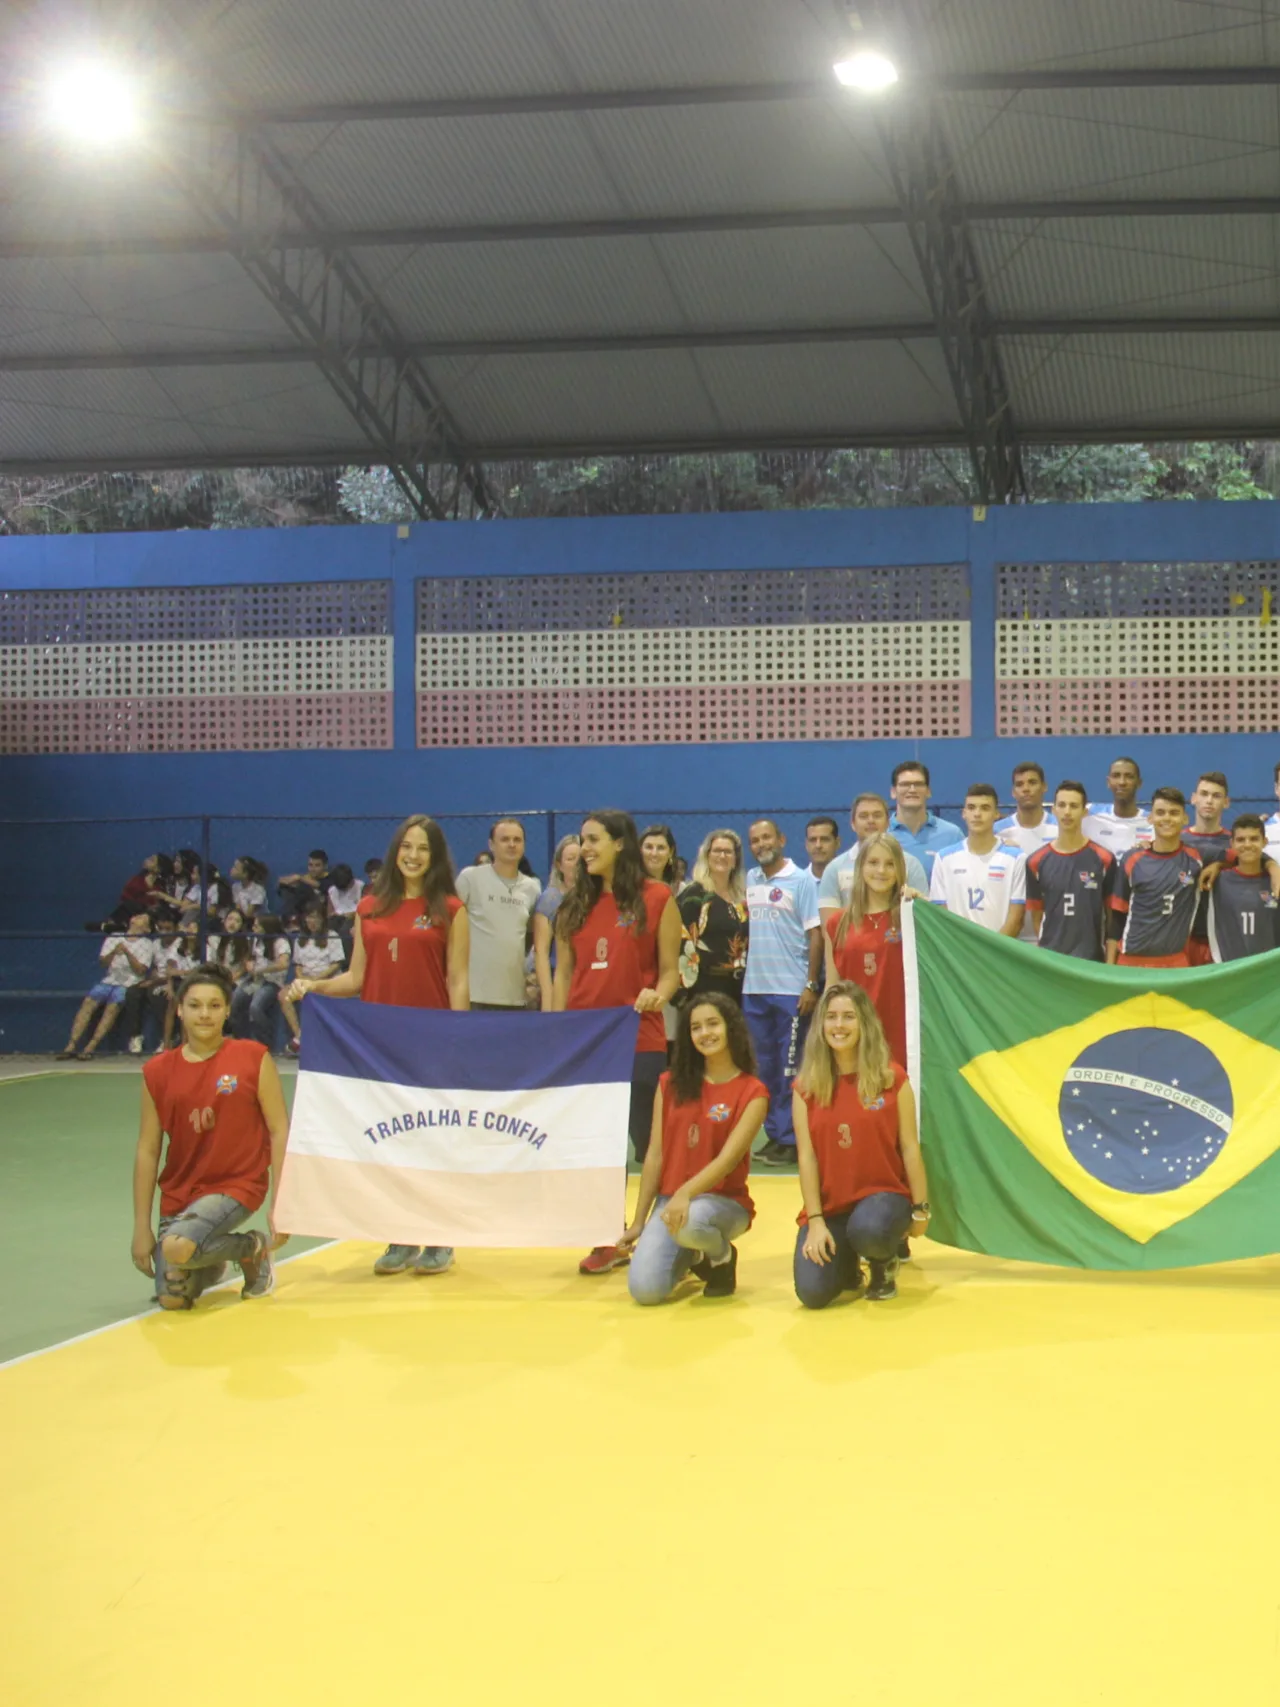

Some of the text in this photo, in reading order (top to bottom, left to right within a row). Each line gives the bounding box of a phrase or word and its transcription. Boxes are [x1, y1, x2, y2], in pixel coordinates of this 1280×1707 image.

[967, 887, 985, 911] 12
[1063, 893, 1075, 916] 2
[1162, 894, 1175, 915] 3
[1241, 912, 1255, 935] 11
[388, 937, 398, 962] 1
[595, 937, 608, 961] 6
[863, 952, 877, 976] 5
[1073, 1070, 1224, 1124] ORDEM E PROGRESSO
[188, 1106, 215, 1134] 10
[364, 1109, 548, 1150] TRABALHA E CONFIA
[837, 1123, 852, 1149] 3
